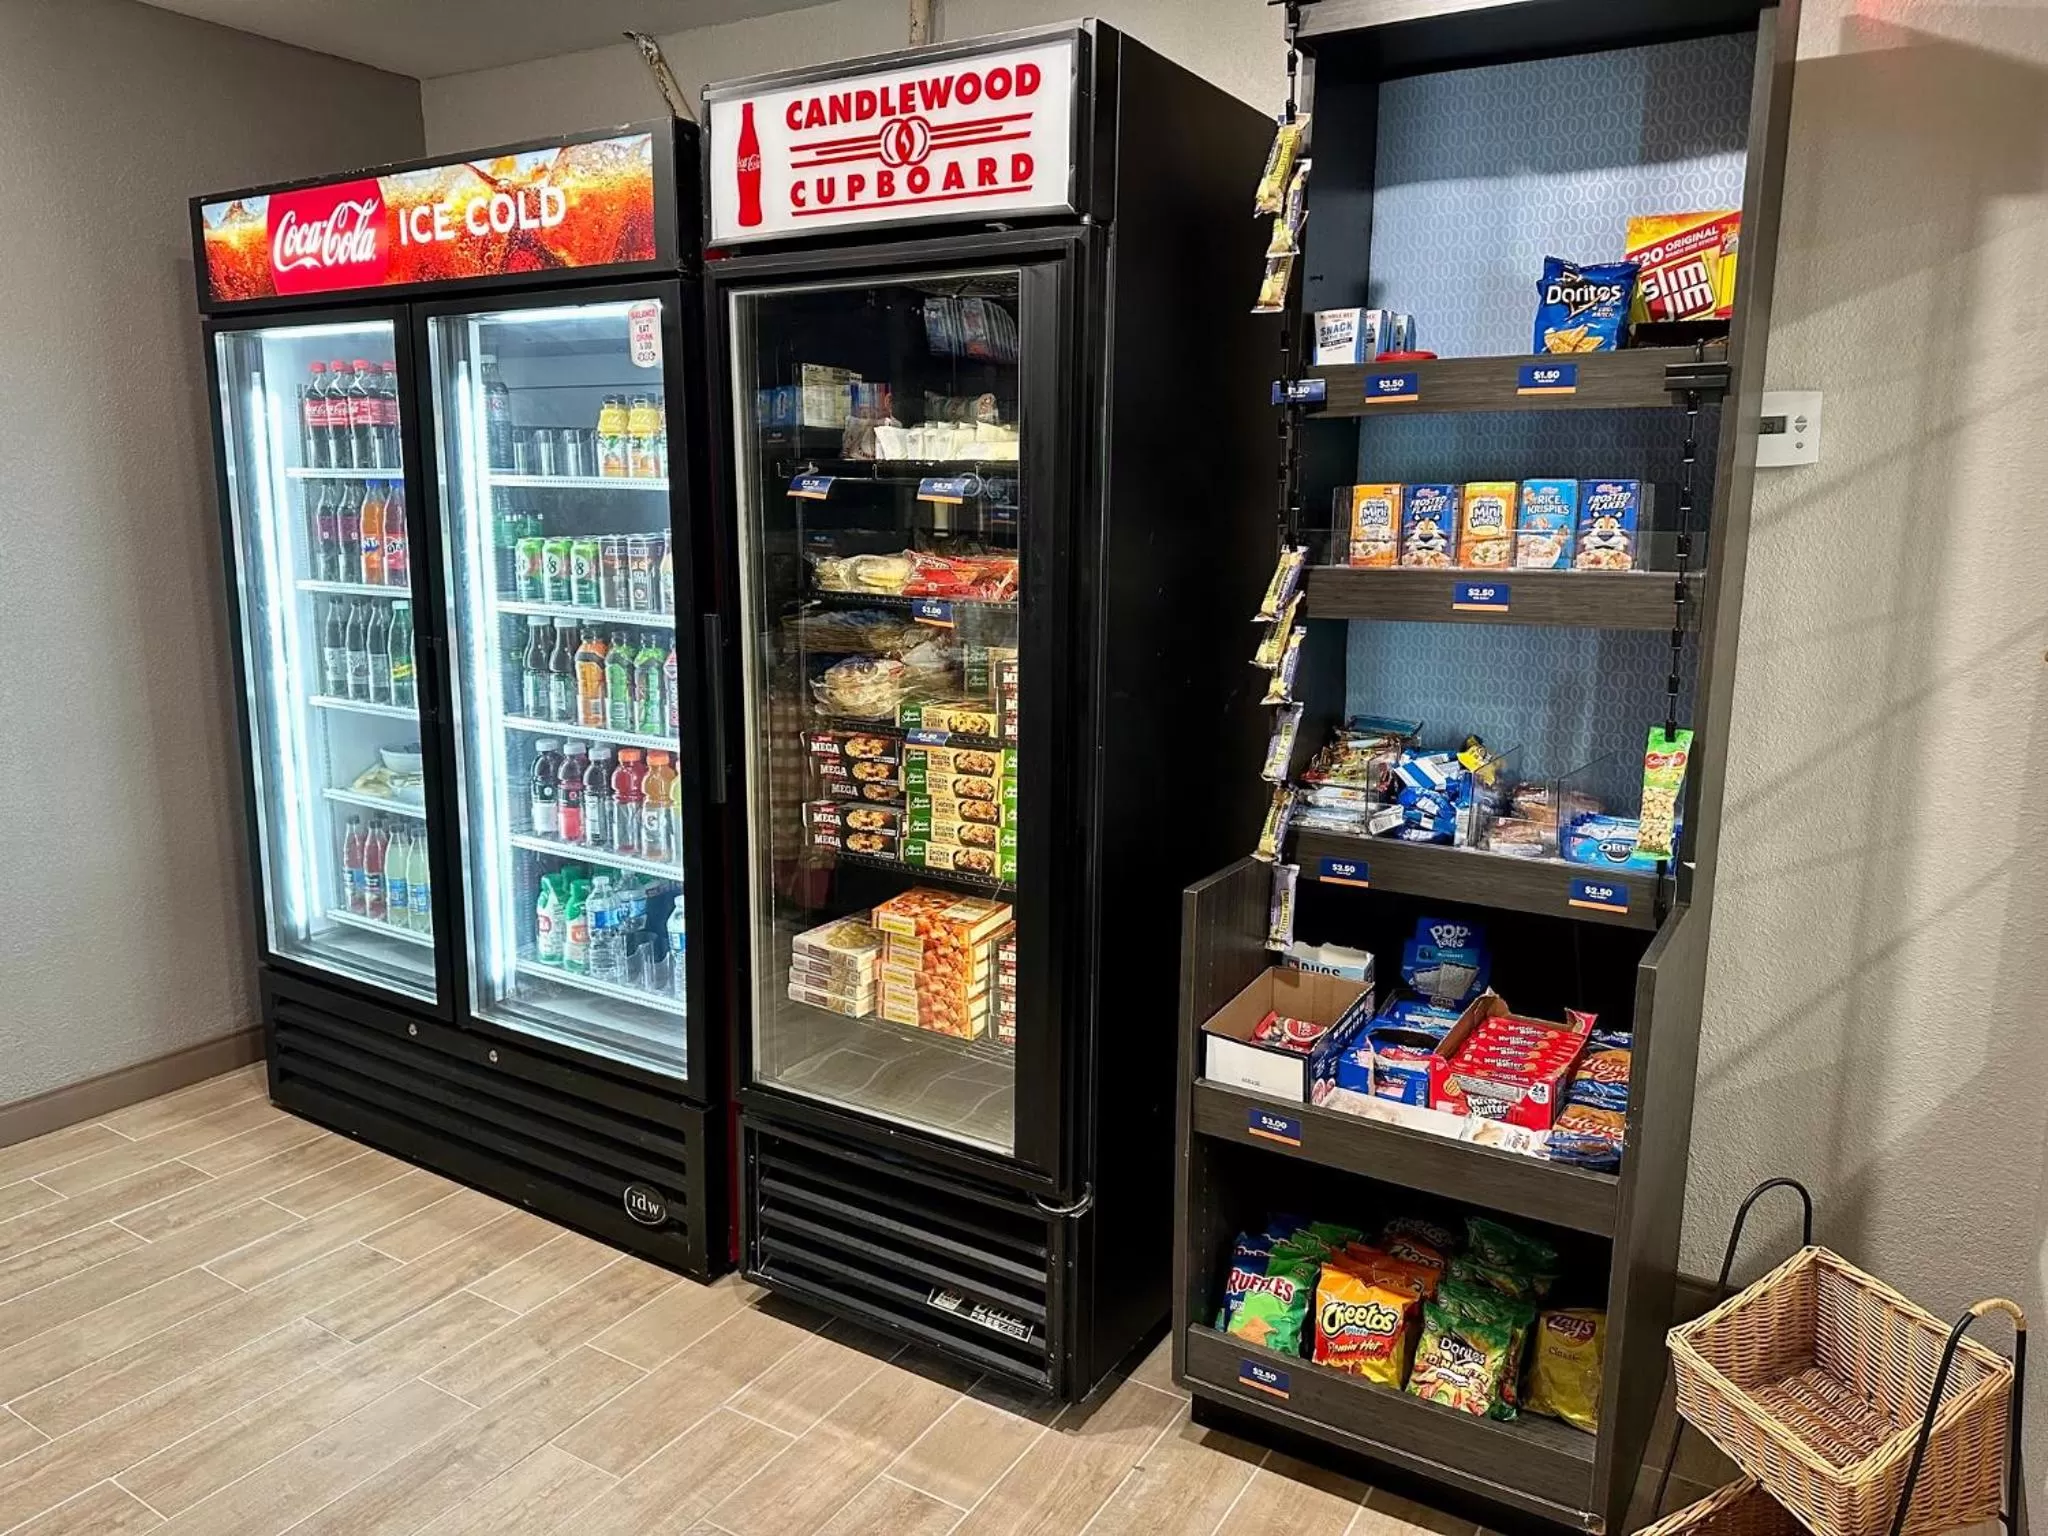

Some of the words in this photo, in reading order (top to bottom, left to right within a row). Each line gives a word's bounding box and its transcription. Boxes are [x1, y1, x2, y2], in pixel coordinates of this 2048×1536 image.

[786, 63, 1041, 131] CANDLEWOOD
[790, 152, 1034, 208] CUPBOARD
[399, 201, 454, 246] ICE
[465, 187, 567, 237] COLD
[273, 197, 379, 272] Coca-Cola
[1665, 226, 1719, 251] ORIGINAL
[1546, 284, 1621, 304] Doritos
[1320, 321, 1353, 336] SNACK
[1538, 495, 1561, 504] RICE
[1588, 493, 1631, 504] FROSTED
[1590, 500, 1626, 511] FLAKES
[1527, 505, 1570, 514] KRISPIES
[811, 742, 839, 754] MEGA
[821, 764, 848, 776] MEGA
[831, 783, 858, 796] MEGA
[813, 813, 841, 825] MEGA
[815, 834, 841, 848] MEGA
[1585, 885, 1613, 897] $2.50
[1532, 1085, 1545, 1093] 24
[1472, 1103, 1510, 1117] Butter
[1227, 1267, 1294, 1304] RUFFLES
[1322, 1302, 1398, 1335] Cheetos
[1440, 1337, 1485, 1365] Doritos
